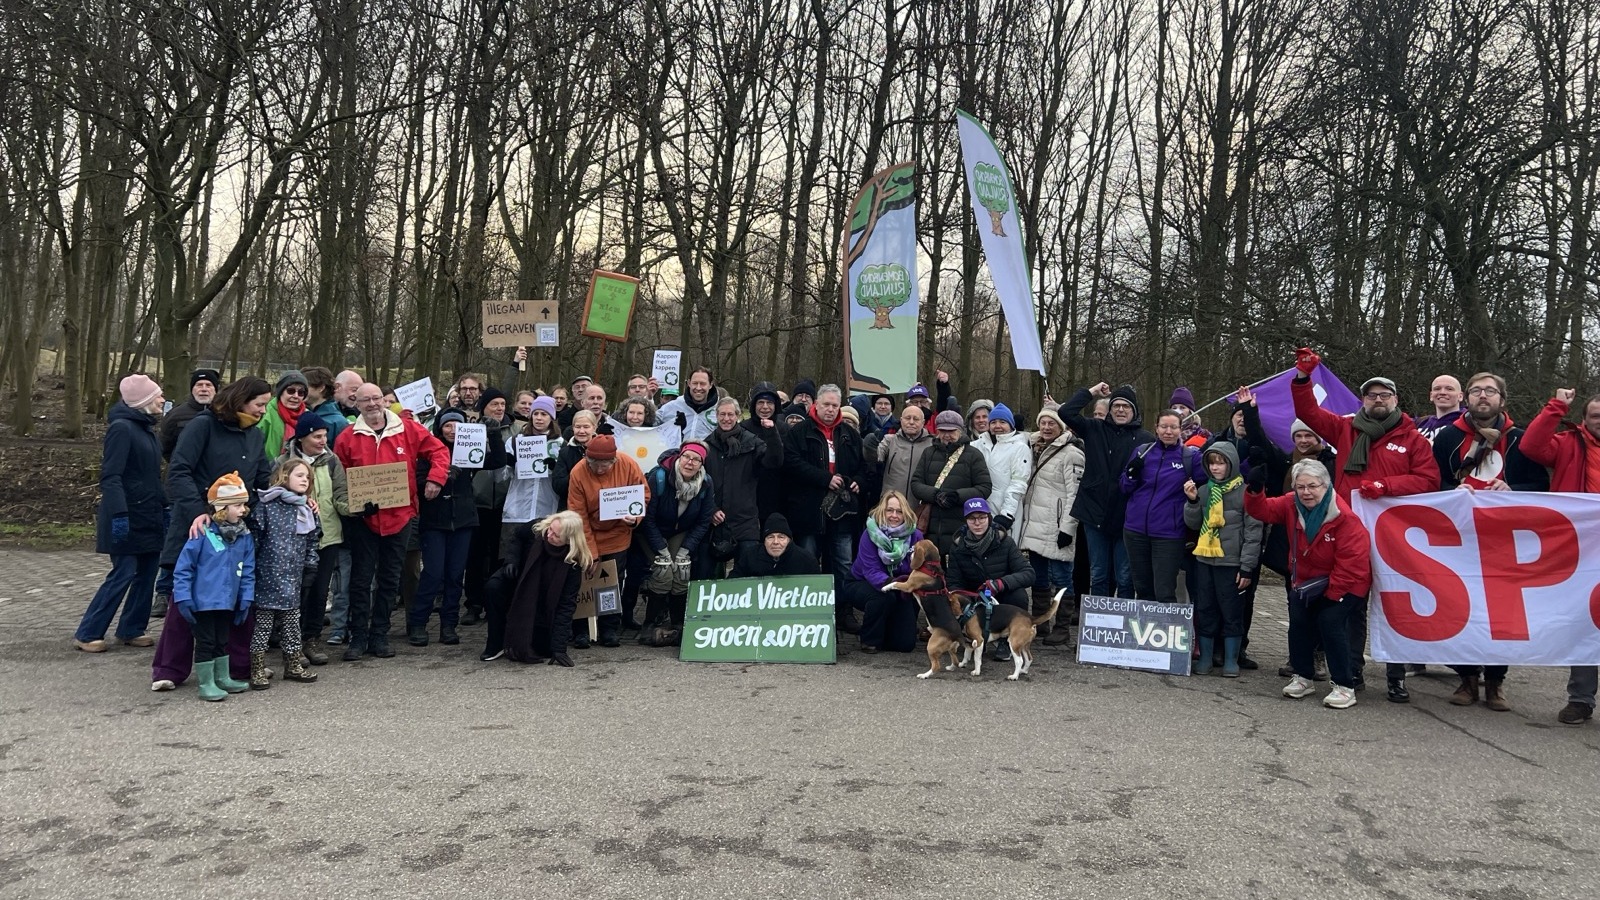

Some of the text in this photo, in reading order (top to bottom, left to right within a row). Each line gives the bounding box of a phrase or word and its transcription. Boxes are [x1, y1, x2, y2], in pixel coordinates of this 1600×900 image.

[486, 323, 535, 335] GEGRAVEN
[458, 426, 483, 434] Kappen
[518, 452, 544, 460] kappen
[617, 488, 632, 496] bouw
[1375, 505, 1580, 642] SP
[697, 583, 752, 612] Houd
[1142, 603, 1194, 620] verandering
[694, 624, 762, 648] groen
[1130, 619, 1187, 651] Volt
